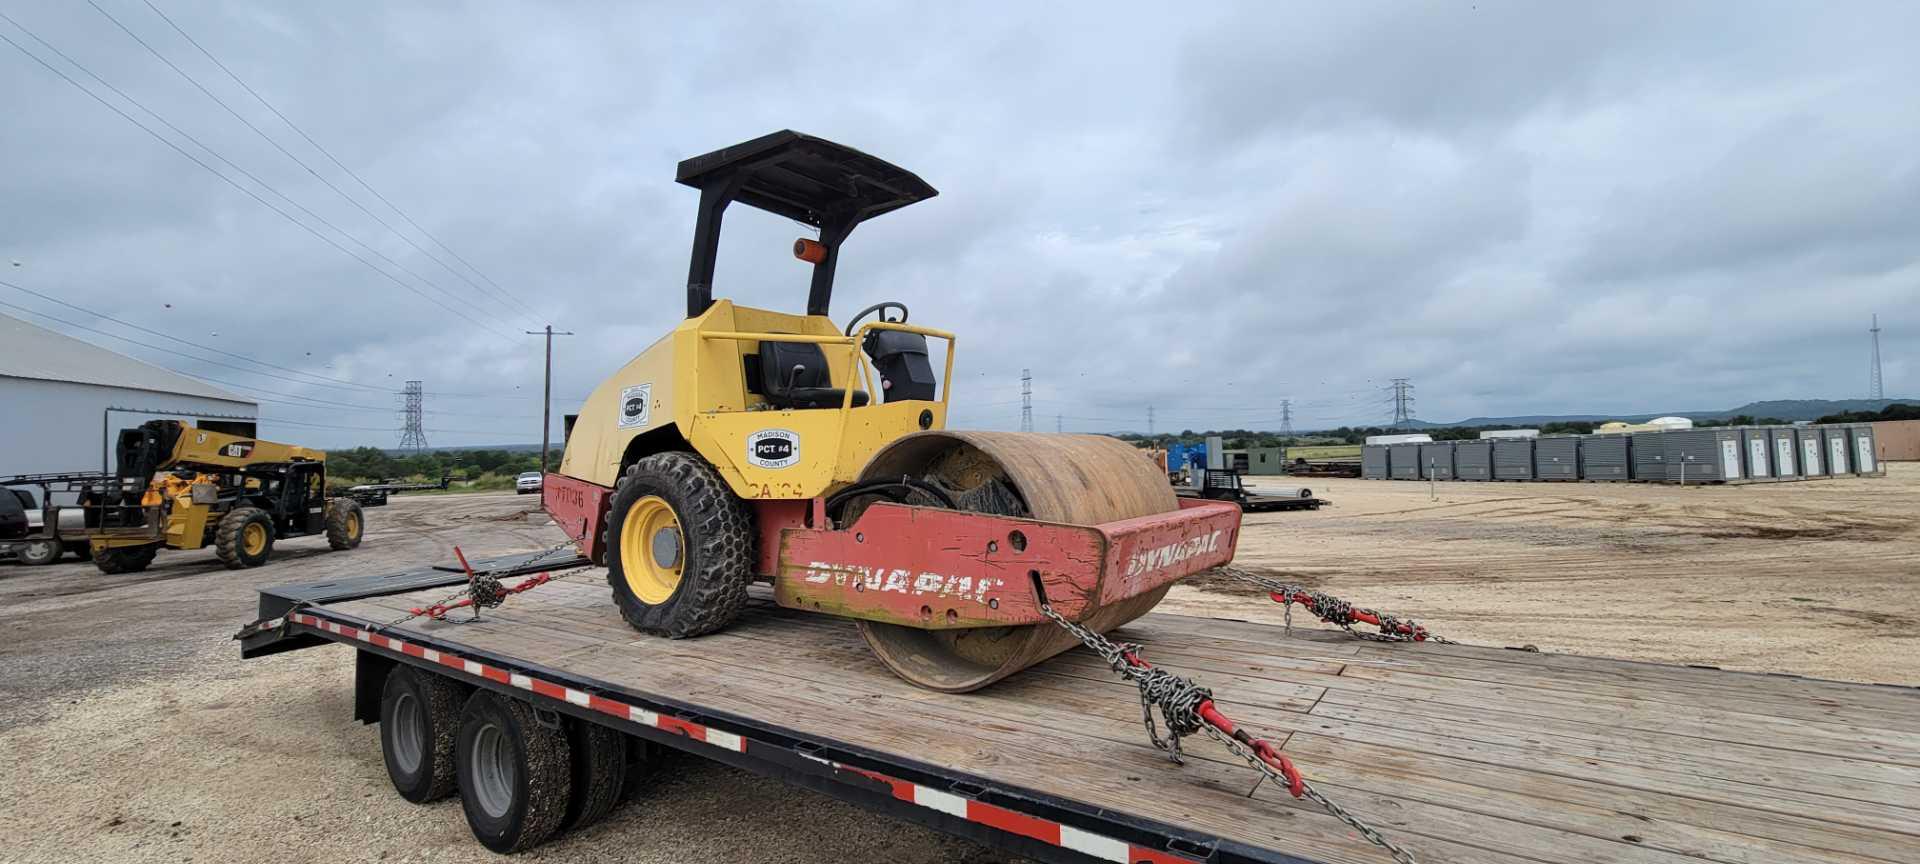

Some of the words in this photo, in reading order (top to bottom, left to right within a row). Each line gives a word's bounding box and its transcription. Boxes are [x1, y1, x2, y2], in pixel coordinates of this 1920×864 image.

[757, 431, 790, 439] MADISON
[758, 445, 775, 453] PCT
[778, 444, 789, 453] #4
[1124, 529, 1221, 578] DYNAPAC
[805, 561, 1004, 603] DYNAPAC
